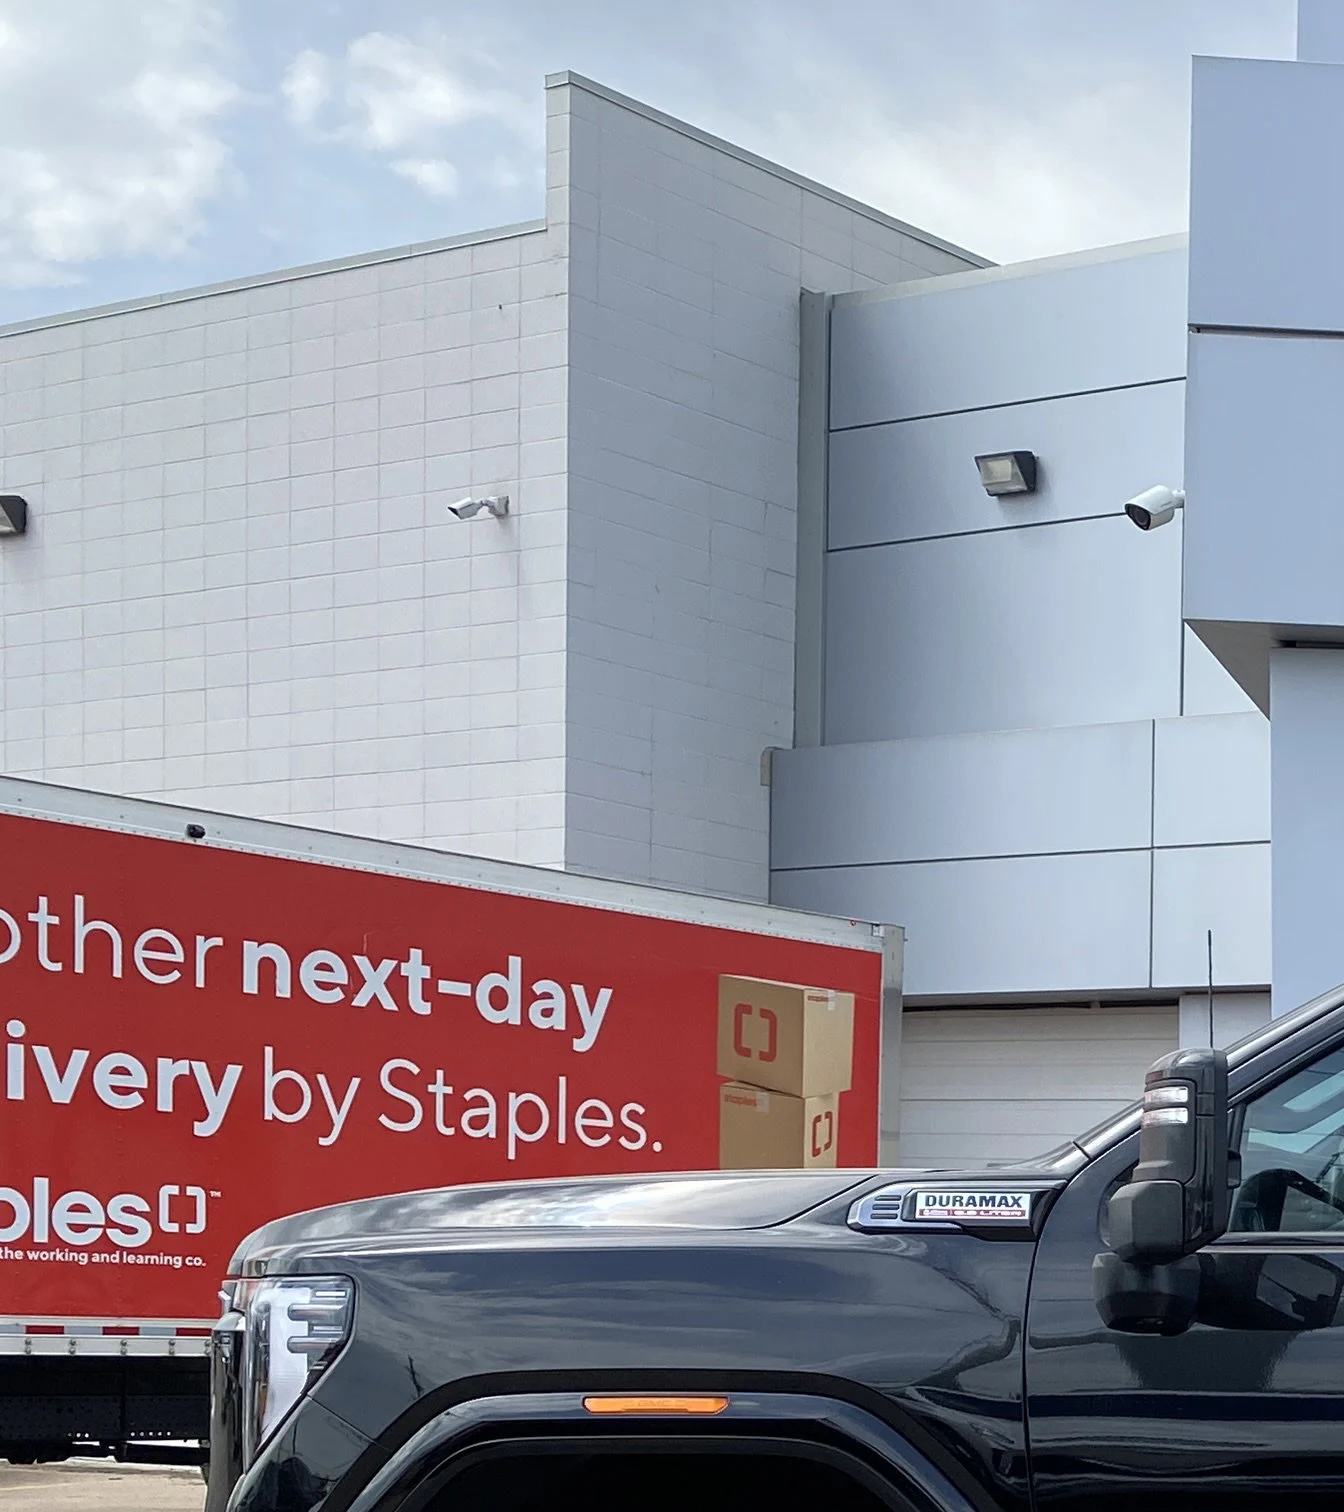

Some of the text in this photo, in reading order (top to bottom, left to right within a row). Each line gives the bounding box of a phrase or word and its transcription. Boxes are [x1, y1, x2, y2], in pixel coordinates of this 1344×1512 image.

[242, 940, 613, 1052] next-day
[263, 1045, 361, 1146] by
[378, 1058, 663, 1160] Staples.
[925, 1195, 1023, 1208] DURAMAX
[27, 1248, 89, 1266] working
[91, 1251, 121, 1264] and
[123, 1252, 182, 1269] learning
[185, 1256, 207, 1268] co.
